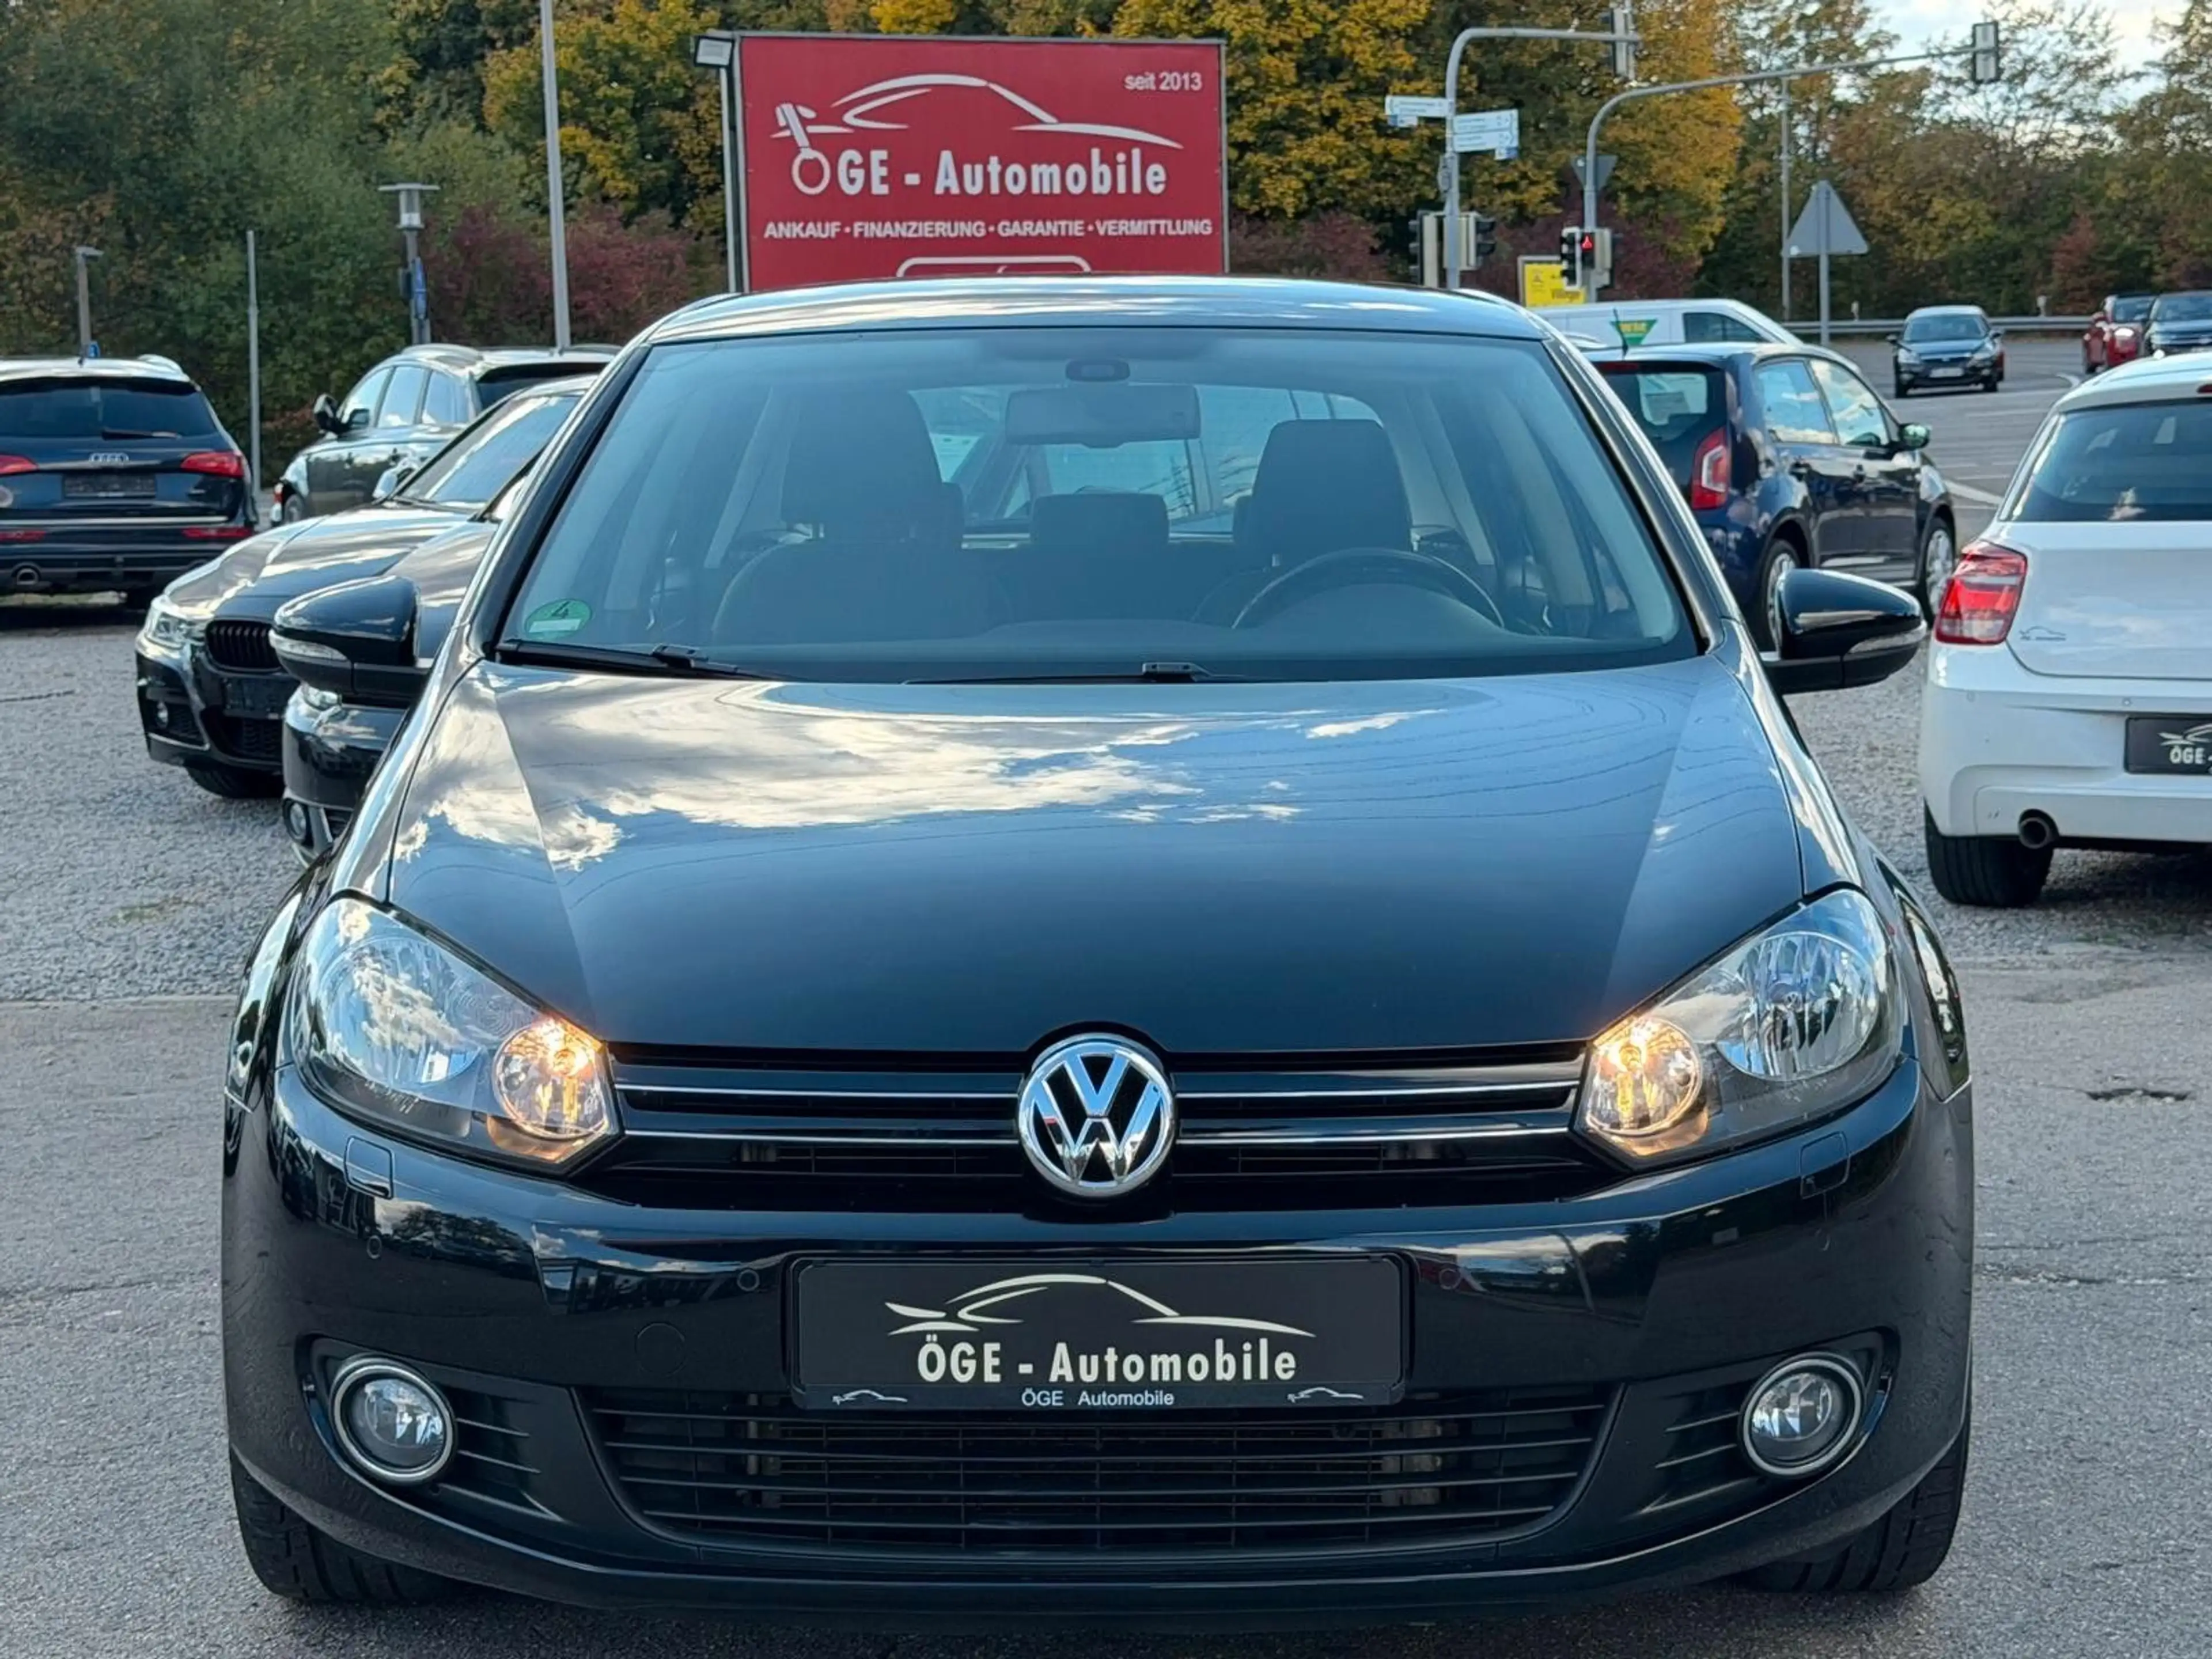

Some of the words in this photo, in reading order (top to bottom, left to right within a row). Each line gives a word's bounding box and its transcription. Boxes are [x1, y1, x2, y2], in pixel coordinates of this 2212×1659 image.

[1124, 71, 1156, 90] seit
[1158, 71, 1203, 90] 2013
[934, 147, 1167, 195] Automobile
[764, 221, 842, 239] ANKAUF
[852, 220, 986, 238] FINANZIERUNG
[997, 219, 1085, 237] GARANTIE
[1094, 218, 1213, 236] VERMITTLUNG
[918, 1334, 1001, 1382] ÖGE
[1048, 1338, 1297, 1382] Automobile
[1021, 1387, 1064, 1406] ÖGE
[1077, 1389, 1175, 1406] Automobile
